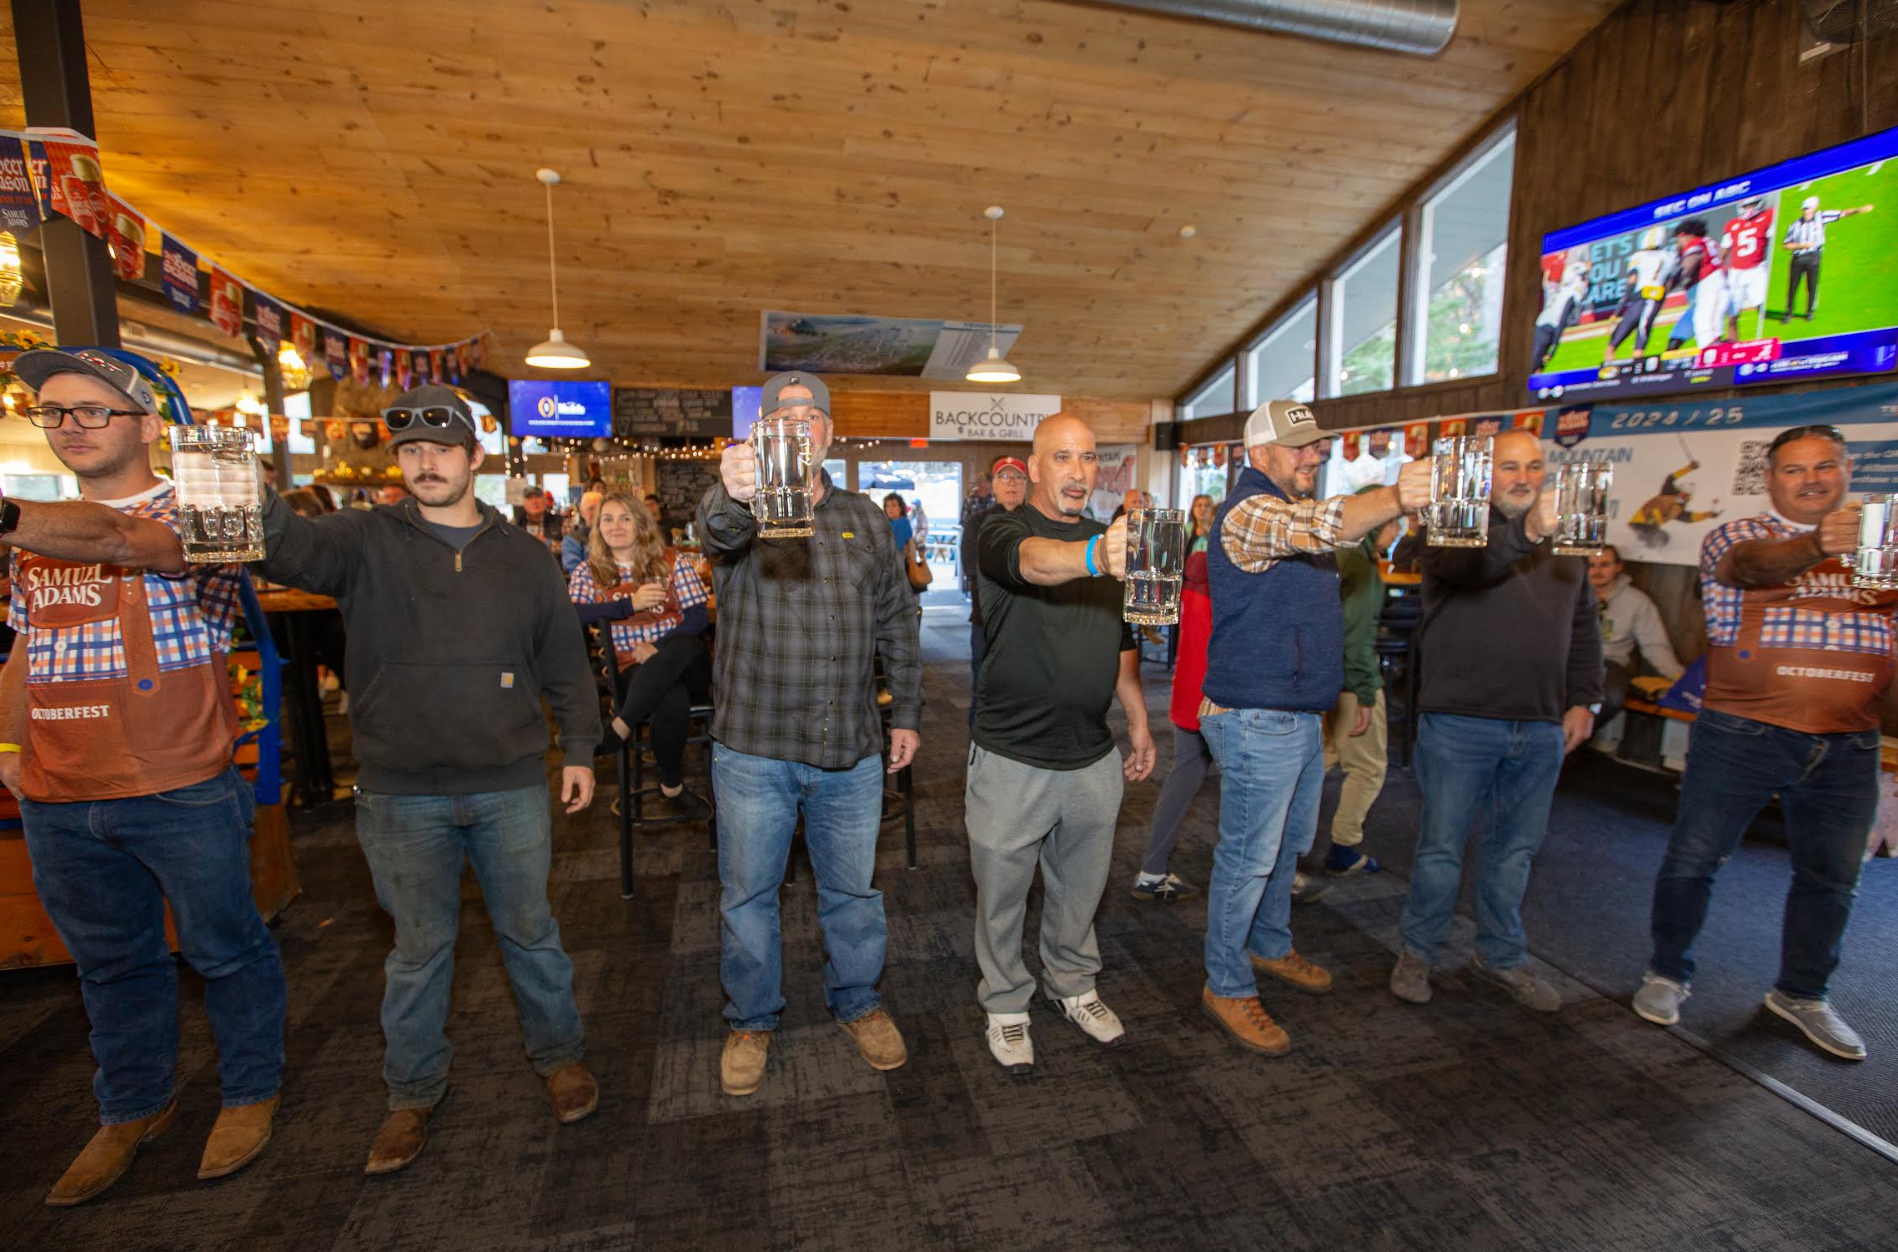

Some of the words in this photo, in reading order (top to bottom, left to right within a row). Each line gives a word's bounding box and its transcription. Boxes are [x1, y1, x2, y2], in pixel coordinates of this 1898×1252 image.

[1588, 233, 1634, 262] ET'S
[1736, 227, 1758, 257] 5
[1588, 258, 1622, 284] OU
[935, 410, 1050, 428] BACKCOUNTR
[1610, 410, 1680, 429] 2024
[1681, 409, 1701, 426] /
[1704, 406, 1745, 426] 25
[967, 428, 986, 437] BAR
[988, 429, 996, 438] &
[998, 429, 1025, 439] GRILL
[1548, 447, 1634, 463] MOUNTAIN
[28, 563, 113, 592] SAMUEL
[1783, 570, 1854, 588] SAMU
[32, 584, 102, 613] ADAMS
[1776, 665, 1875, 683] OCTOBERFEST
[31, 705, 110, 720] OCTOBERFEST
